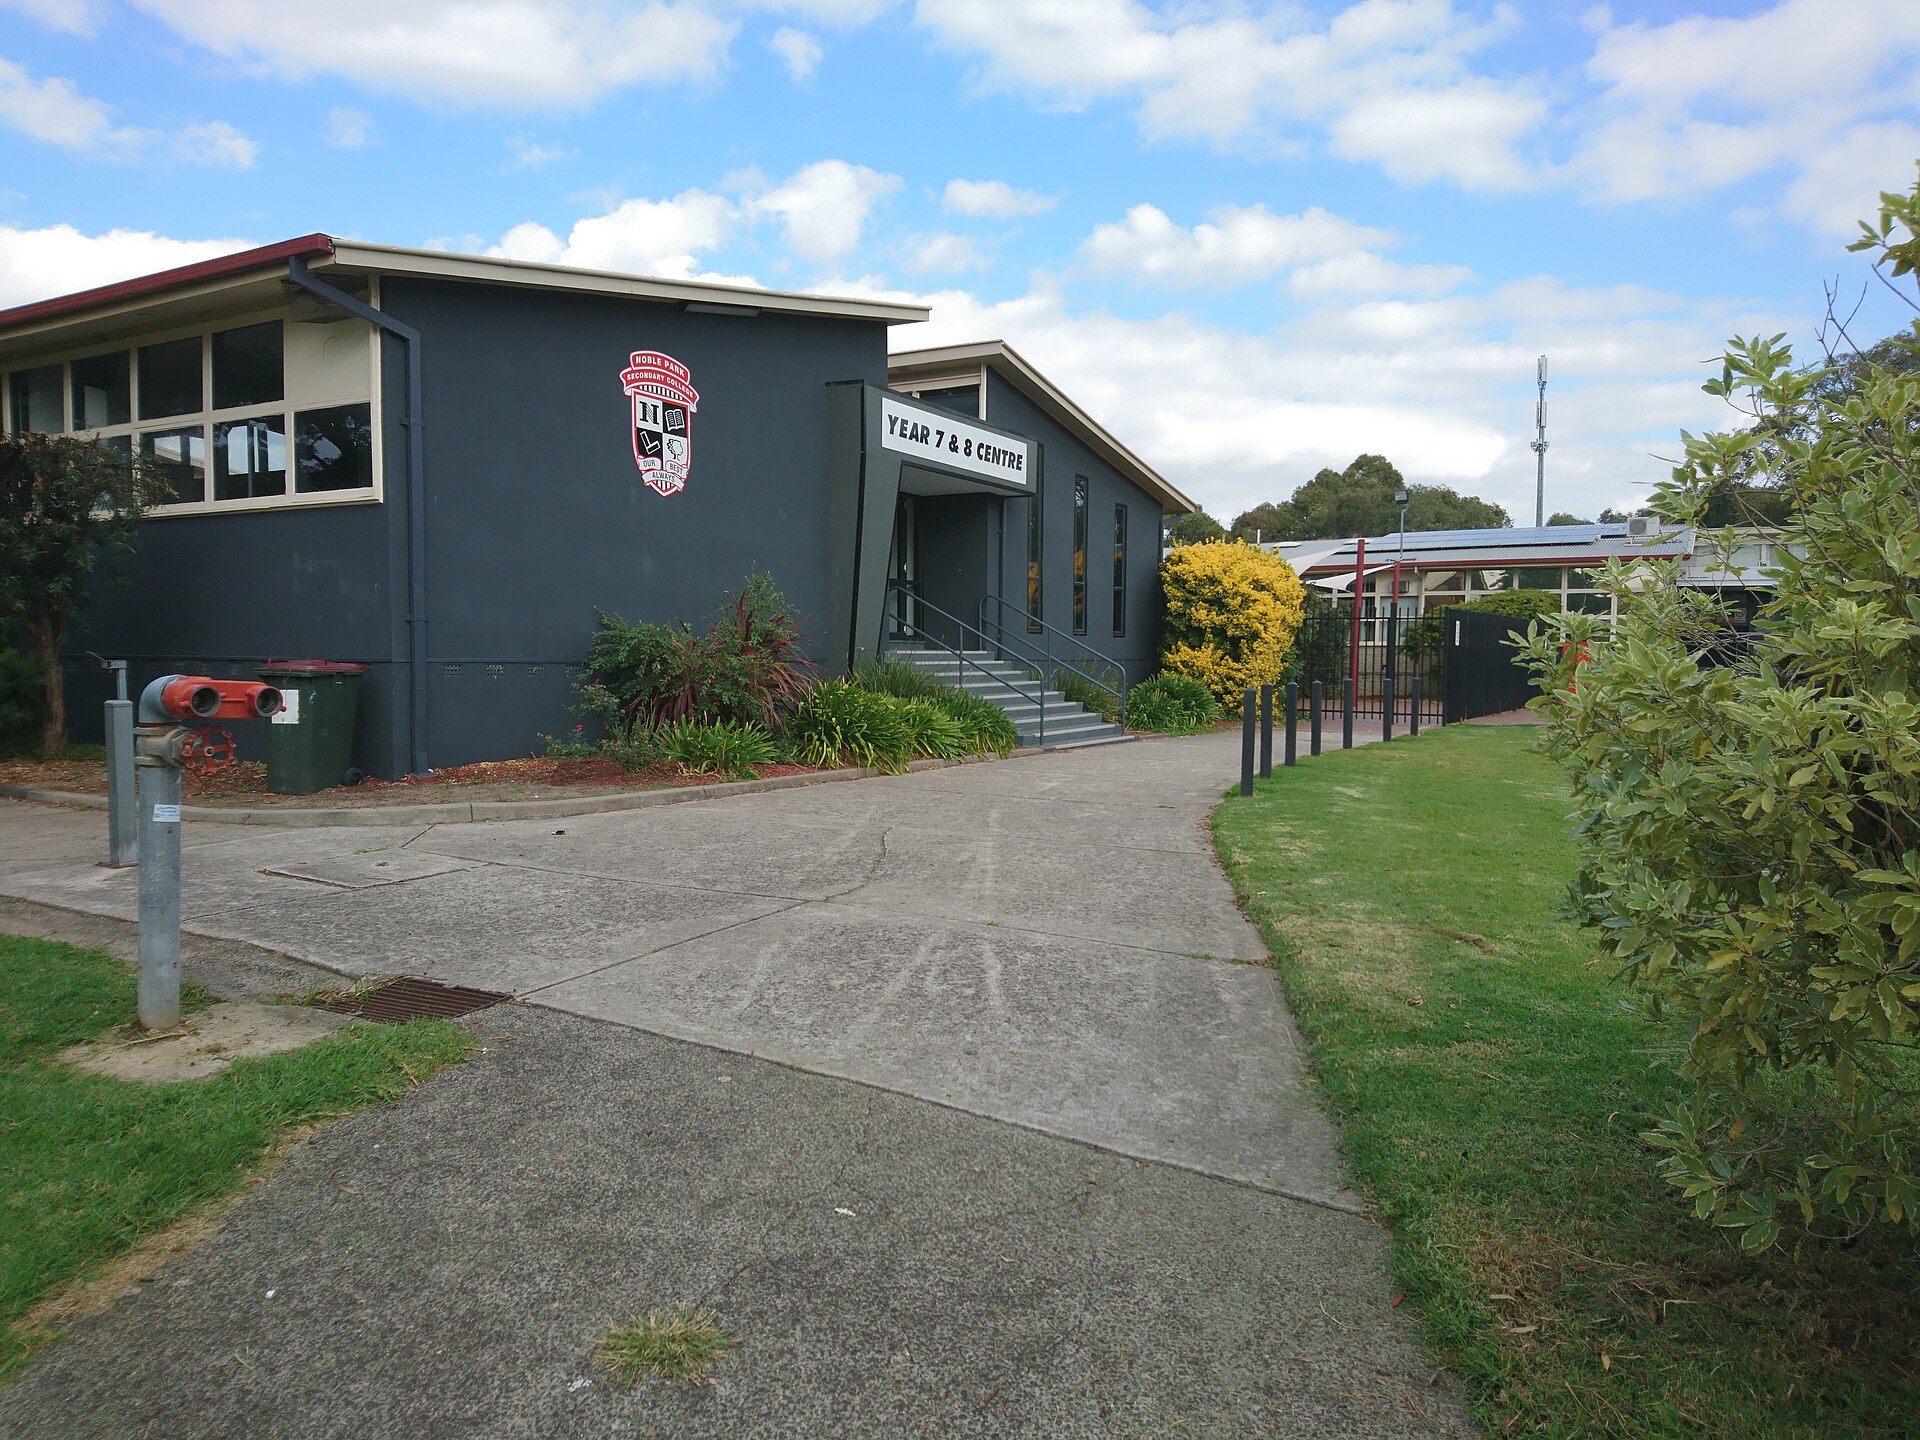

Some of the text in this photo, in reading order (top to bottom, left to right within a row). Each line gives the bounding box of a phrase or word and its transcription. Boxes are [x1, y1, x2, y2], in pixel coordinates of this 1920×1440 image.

[635, 355, 685, 378] NOBLE PARK
[626, 372, 694, 399] SECONDARY COLLEGE
[887, 413, 1023, 471] YEAR 7 & 8 CENTRE
[643, 460, 656, 468] OUR
[669, 463, 684, 475] BEST
[652, 471, 676, 482] ALWAYS
